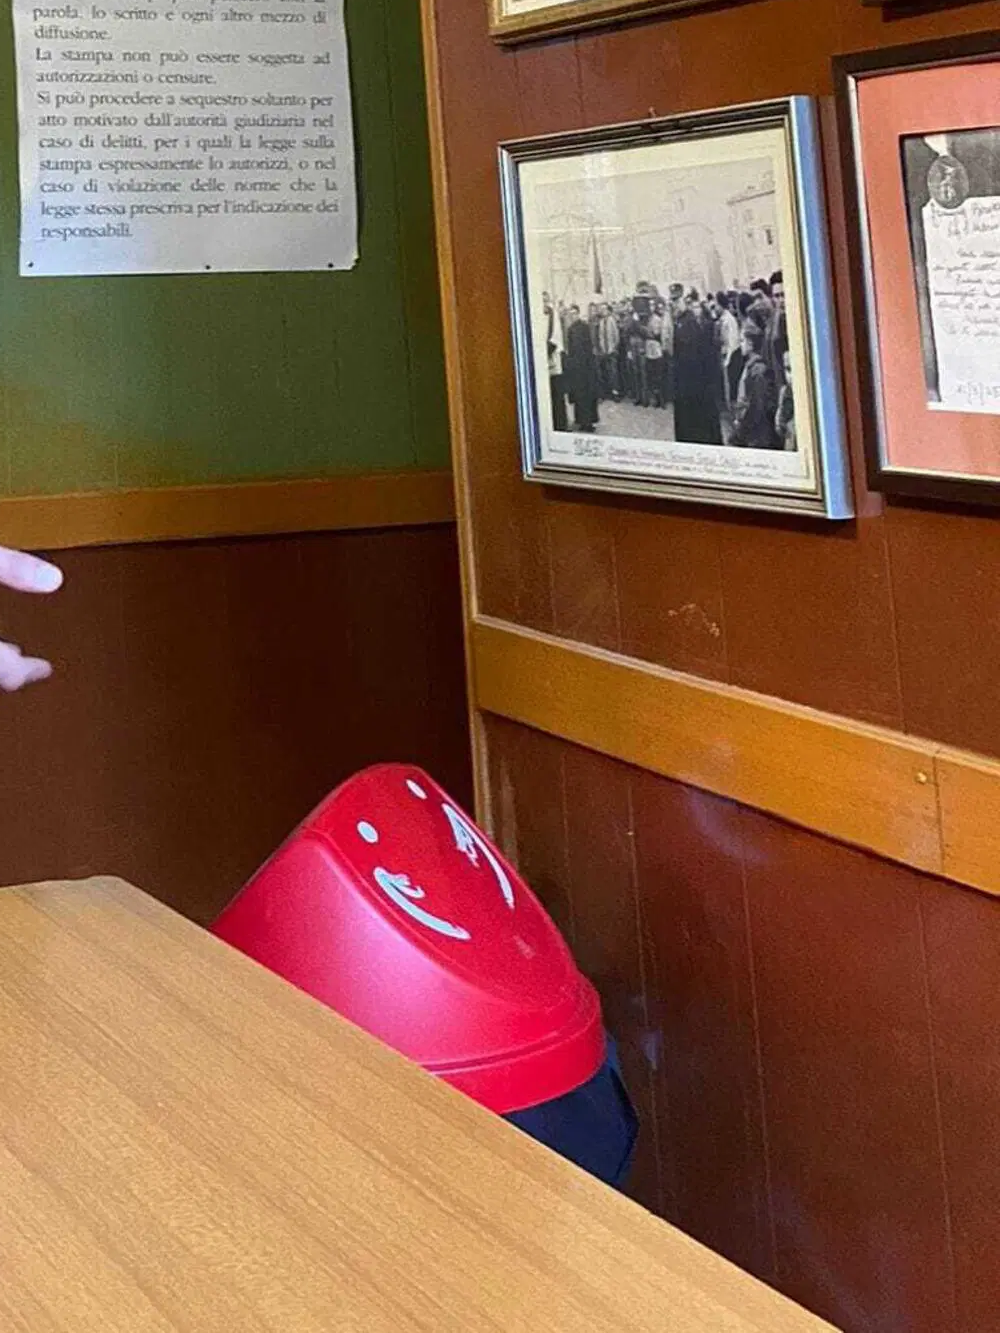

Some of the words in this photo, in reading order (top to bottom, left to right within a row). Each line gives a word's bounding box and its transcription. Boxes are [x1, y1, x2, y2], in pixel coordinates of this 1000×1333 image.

[91, 5, 106, 19] lo
[114, 7, 157, 20] scritto
[165, 11, 174, 21] e
[181, 9, 213, 23] ogni
[221, 8, 253, 21] altro
[260, 12, 305, 23] mezzo
[313, 11, 326, 23] di
[34, 25, 112, 40] diffusione.
[35, 47, 52, 61] La
[61, 50, 113, 65] stampa
[122, 51, 151, 62] non
[159, 49, 189, 65] può
[196, 53, 240, 63] essere
[248, 52, 304, 67] soggetta
[312, 51, 330, 64] ad
[35, 70, 138, 83] autorizzazioni
[143, 74, 153, 83] o
[158, 73, 217, 84] censure.
[37, 91, 50, 104] Si
[55, 91, 85, 109] può
[89, 91, 163, 108] procedere
[165, 95, 175, 105] a
[180, 94, 248, 109] sequestro
[251, 92, 306, 106] soltanto
[310, 96, 333, 109] per
[38, 115, 67, 126] atto
[73, 114, 138, 126] motivato
[234, 114, 305, 131] giudiziaria
[312, 114, 334, 127] nel
[39, 137, 72, 148] caso
[79, 135, 94, 148] di
[101, 135, 147, 150] delitti,
[153, 137, 178, 151] per
[184, 135, 191, 148] i
[197, 135, 232, 151] quali
[239, 135, 252, 148] la
[258, 135, 297, 152] legge
[302, 135, 335, 148] sulla
[40, 158, 92, 174] stampa
[98, 158, 204, 174] espressamente
[208, 156, 223, 170] lo
[228, 157, 293, 172] autorizzi,
[298, 160, 309, 170] o
[314, 156, 336, 170] nel
[40, 182, 74, 193] caso
[83, 178, 98, 193] di
[107, 178, 182, 192] violazione
[190, 177, 225, 191] delle
[234, 181, 281, 191] norme
[290, 178, 316, 191] che
[325, 177, 338, 191] la
[41, 201, 81, 218] legge
[84, 203, 126, 214] stessa
[130, 203, 193, 218] prescriva
[197, 203, 220, 217] per
[223, 199, 313, 214] l'indicazione
[315, 199, 339, 213] dei
[41, 223, 133, 241] responsabili.
